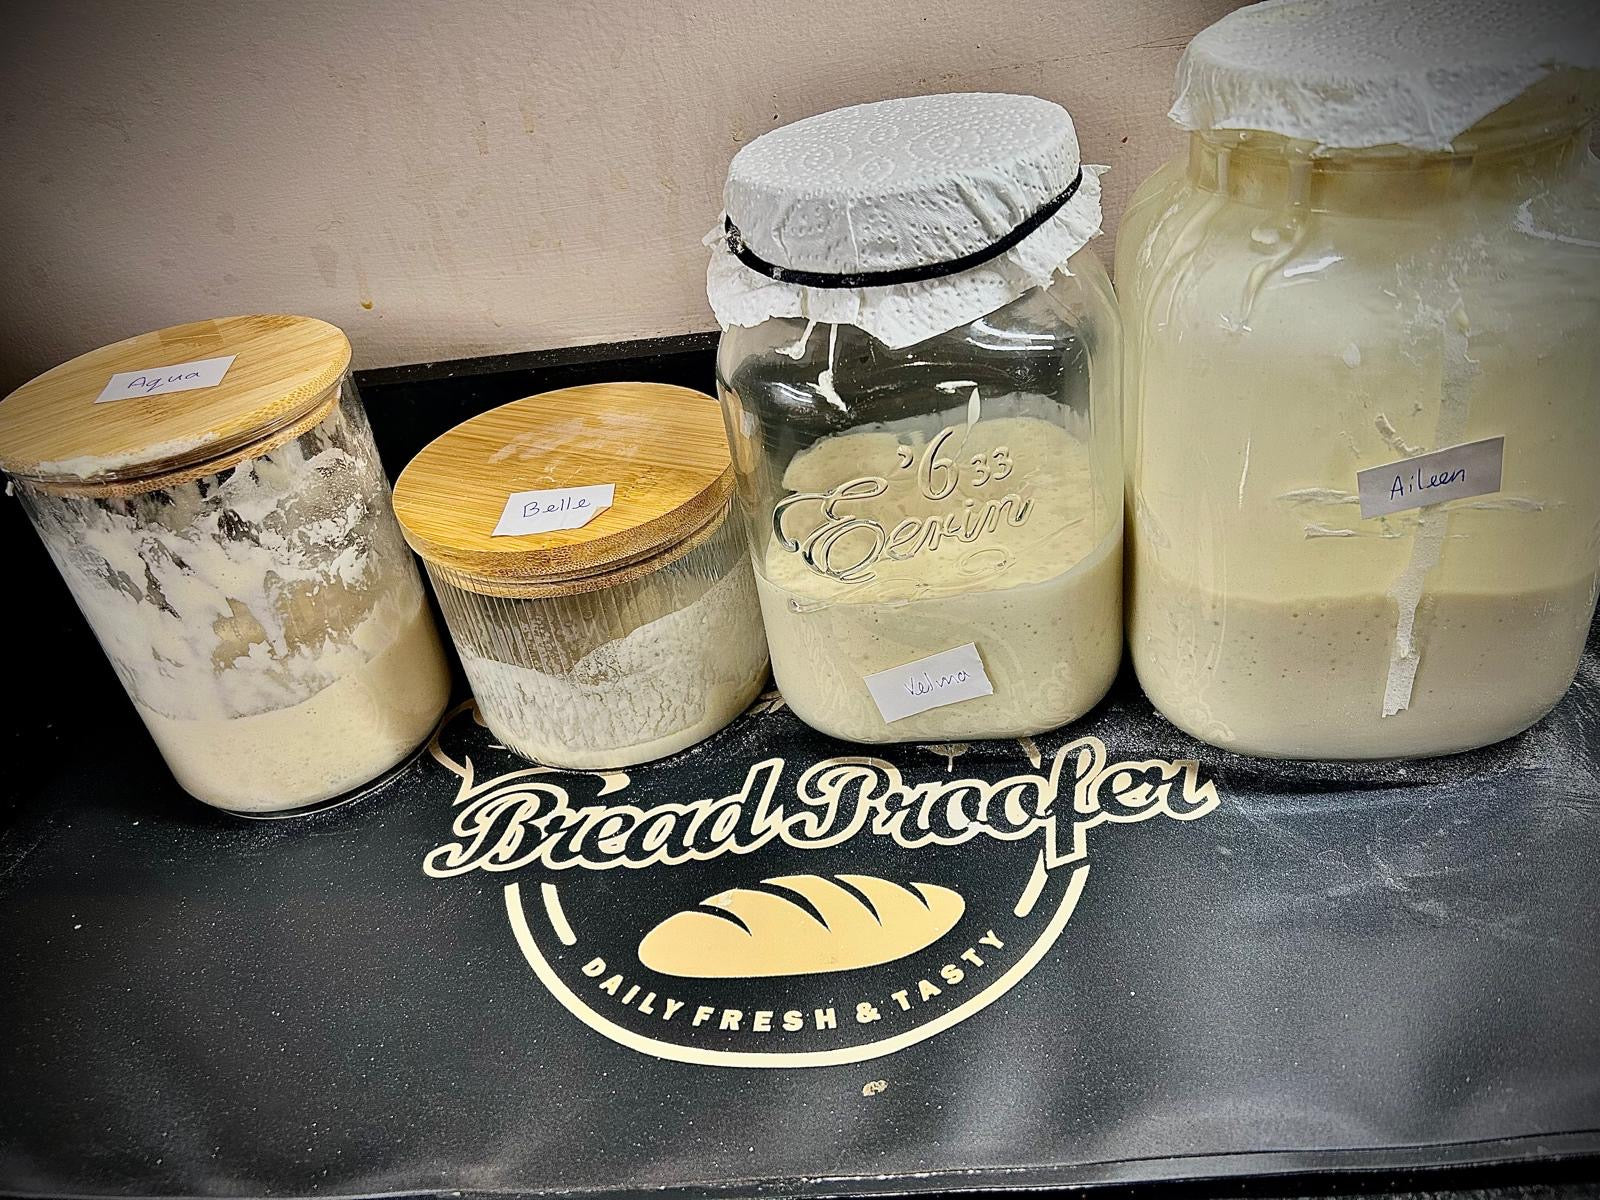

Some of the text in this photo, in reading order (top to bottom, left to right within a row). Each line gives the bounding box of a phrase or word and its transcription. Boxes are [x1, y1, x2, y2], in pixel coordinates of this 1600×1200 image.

[127, 371, 200, 393] Aqua
[1390, 467, 1465, 500] Aileen
[522, 496, 591, 518] Belle
[903, 670, 971, 696] Velma
[423, 736, 1221, 878] Bread Proofer
[581, 929, 1005, 1032] DAILY FRESH & TASTY
